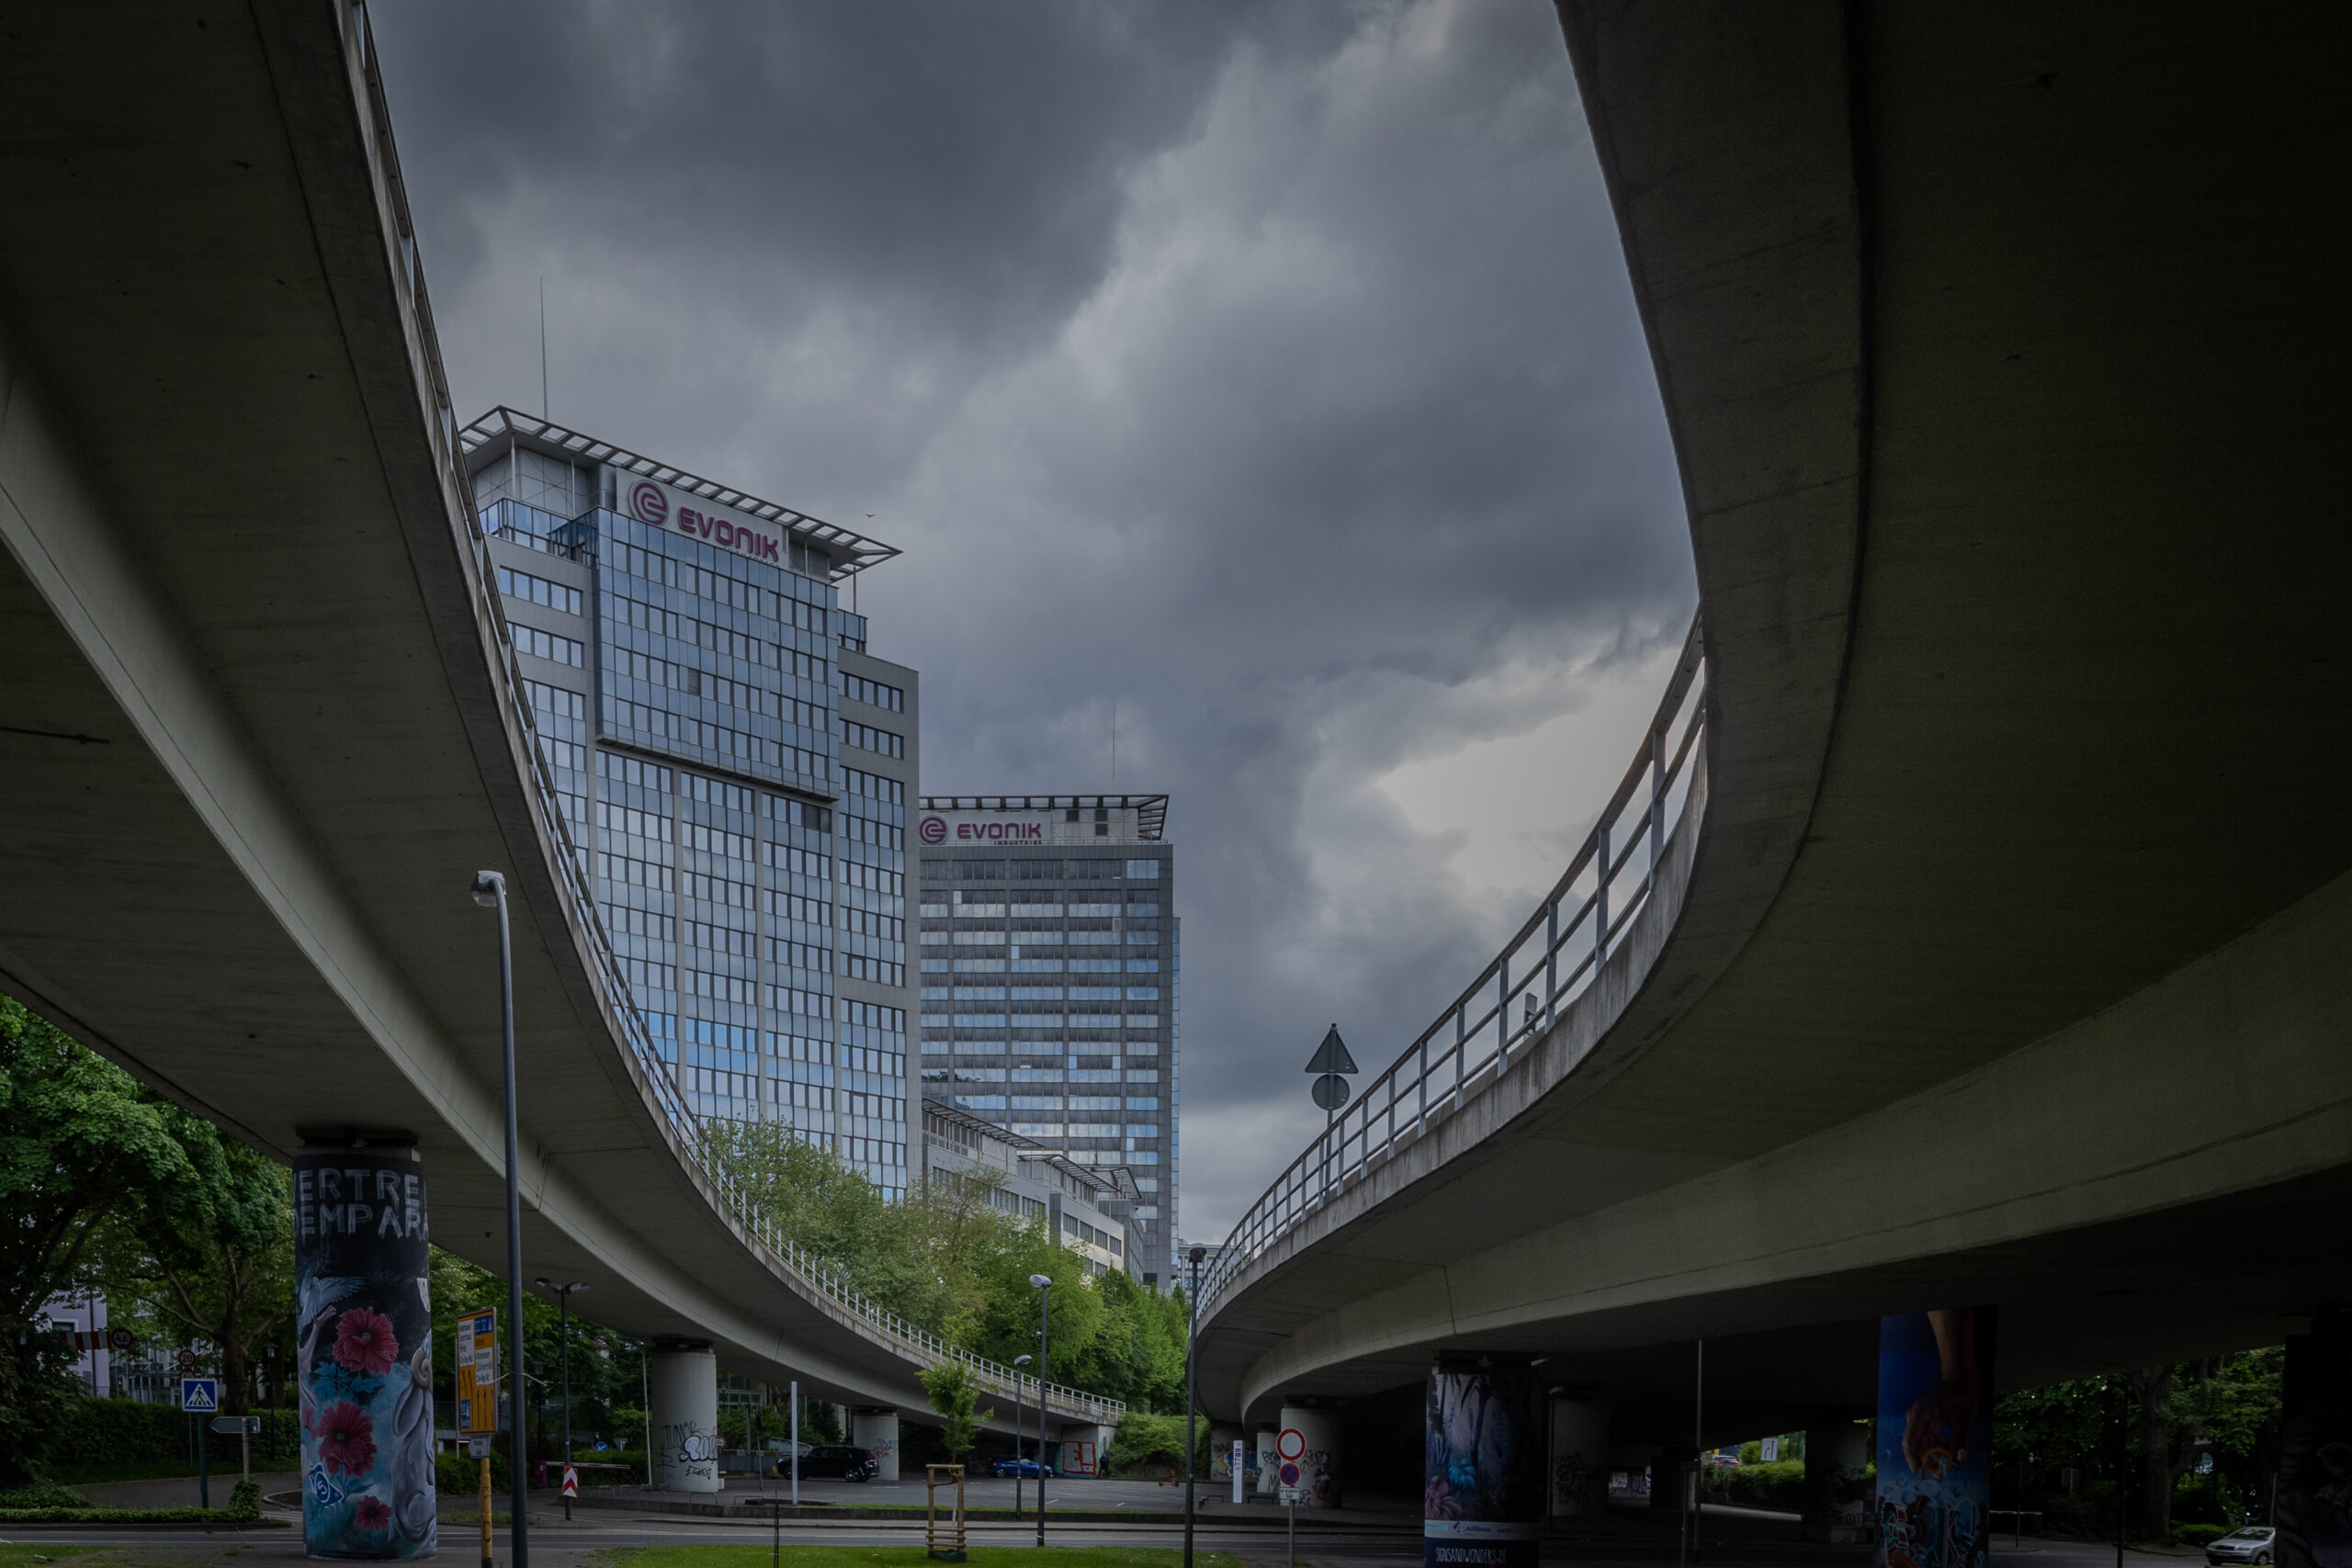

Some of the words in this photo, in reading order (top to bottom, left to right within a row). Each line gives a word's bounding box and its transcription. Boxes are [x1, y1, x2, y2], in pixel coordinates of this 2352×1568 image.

[679, 506, 779, 562] EVONIK
[957, 823, 1042, 840] EVONIK
[180, 1354, 192, 1362] 20
